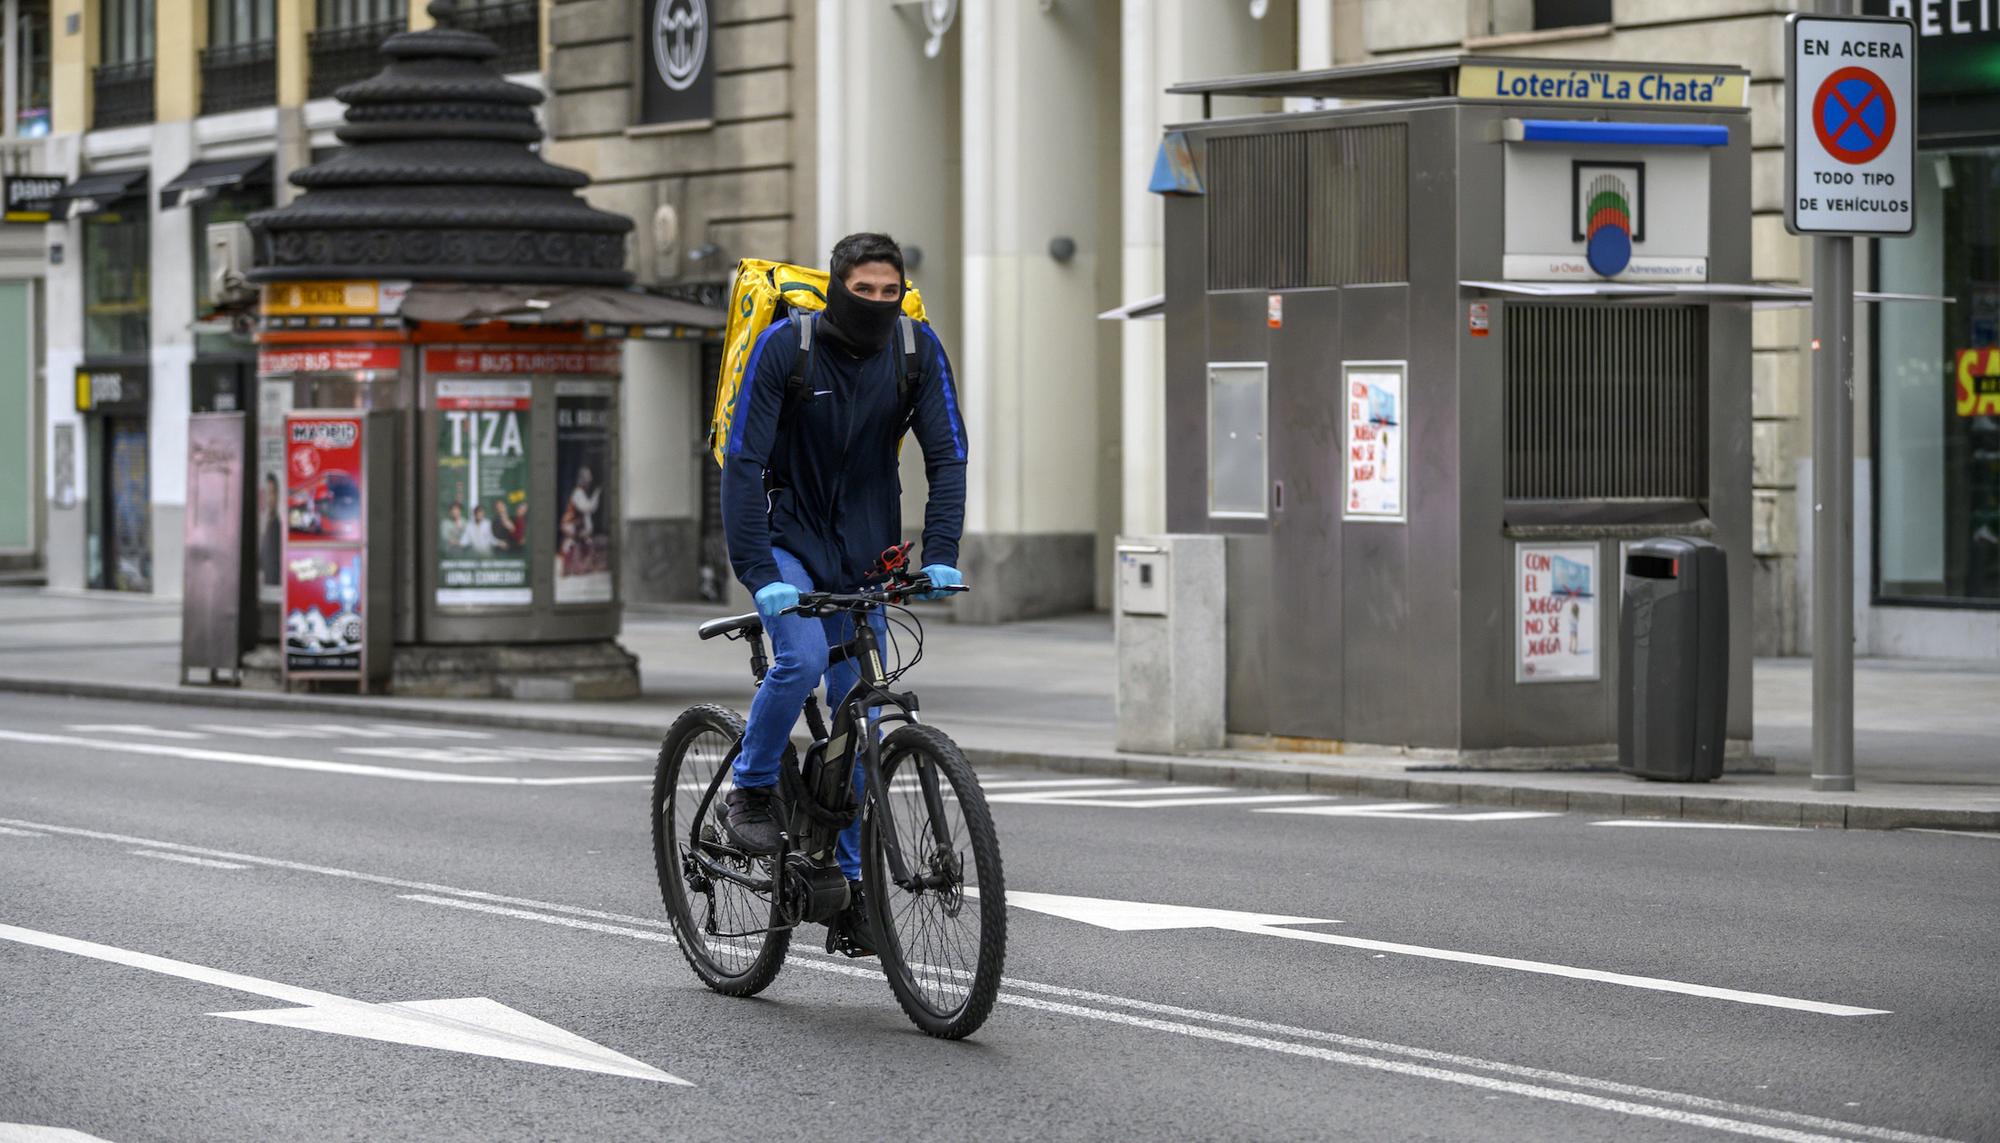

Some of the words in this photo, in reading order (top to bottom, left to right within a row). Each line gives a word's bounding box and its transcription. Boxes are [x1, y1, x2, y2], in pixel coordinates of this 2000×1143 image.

[1804, 40, 1829, 56] EN
[1841, 41, 1904, 59] ACERA
[1814, 171, 1854, 185] TODO
[1862, 173, 1895, 186] TIPO
[1800, 198, 1818, 210] DE
[1826, 197, 1909, 213] VEHÍCULOS
[1352, 382, 1368, 398] CON
[446, 411, 524, 454] TIZA
[1525, 554, 1551, 571] CON
[1525, 574, 1537, 593] EL
[1526, 596, 1563, 615] JUEGO
[1525, 619, 1543, 635] NO
[1549, 617, 1560, 634] SE
[1526, 638, 1561, 657] JUEGA
